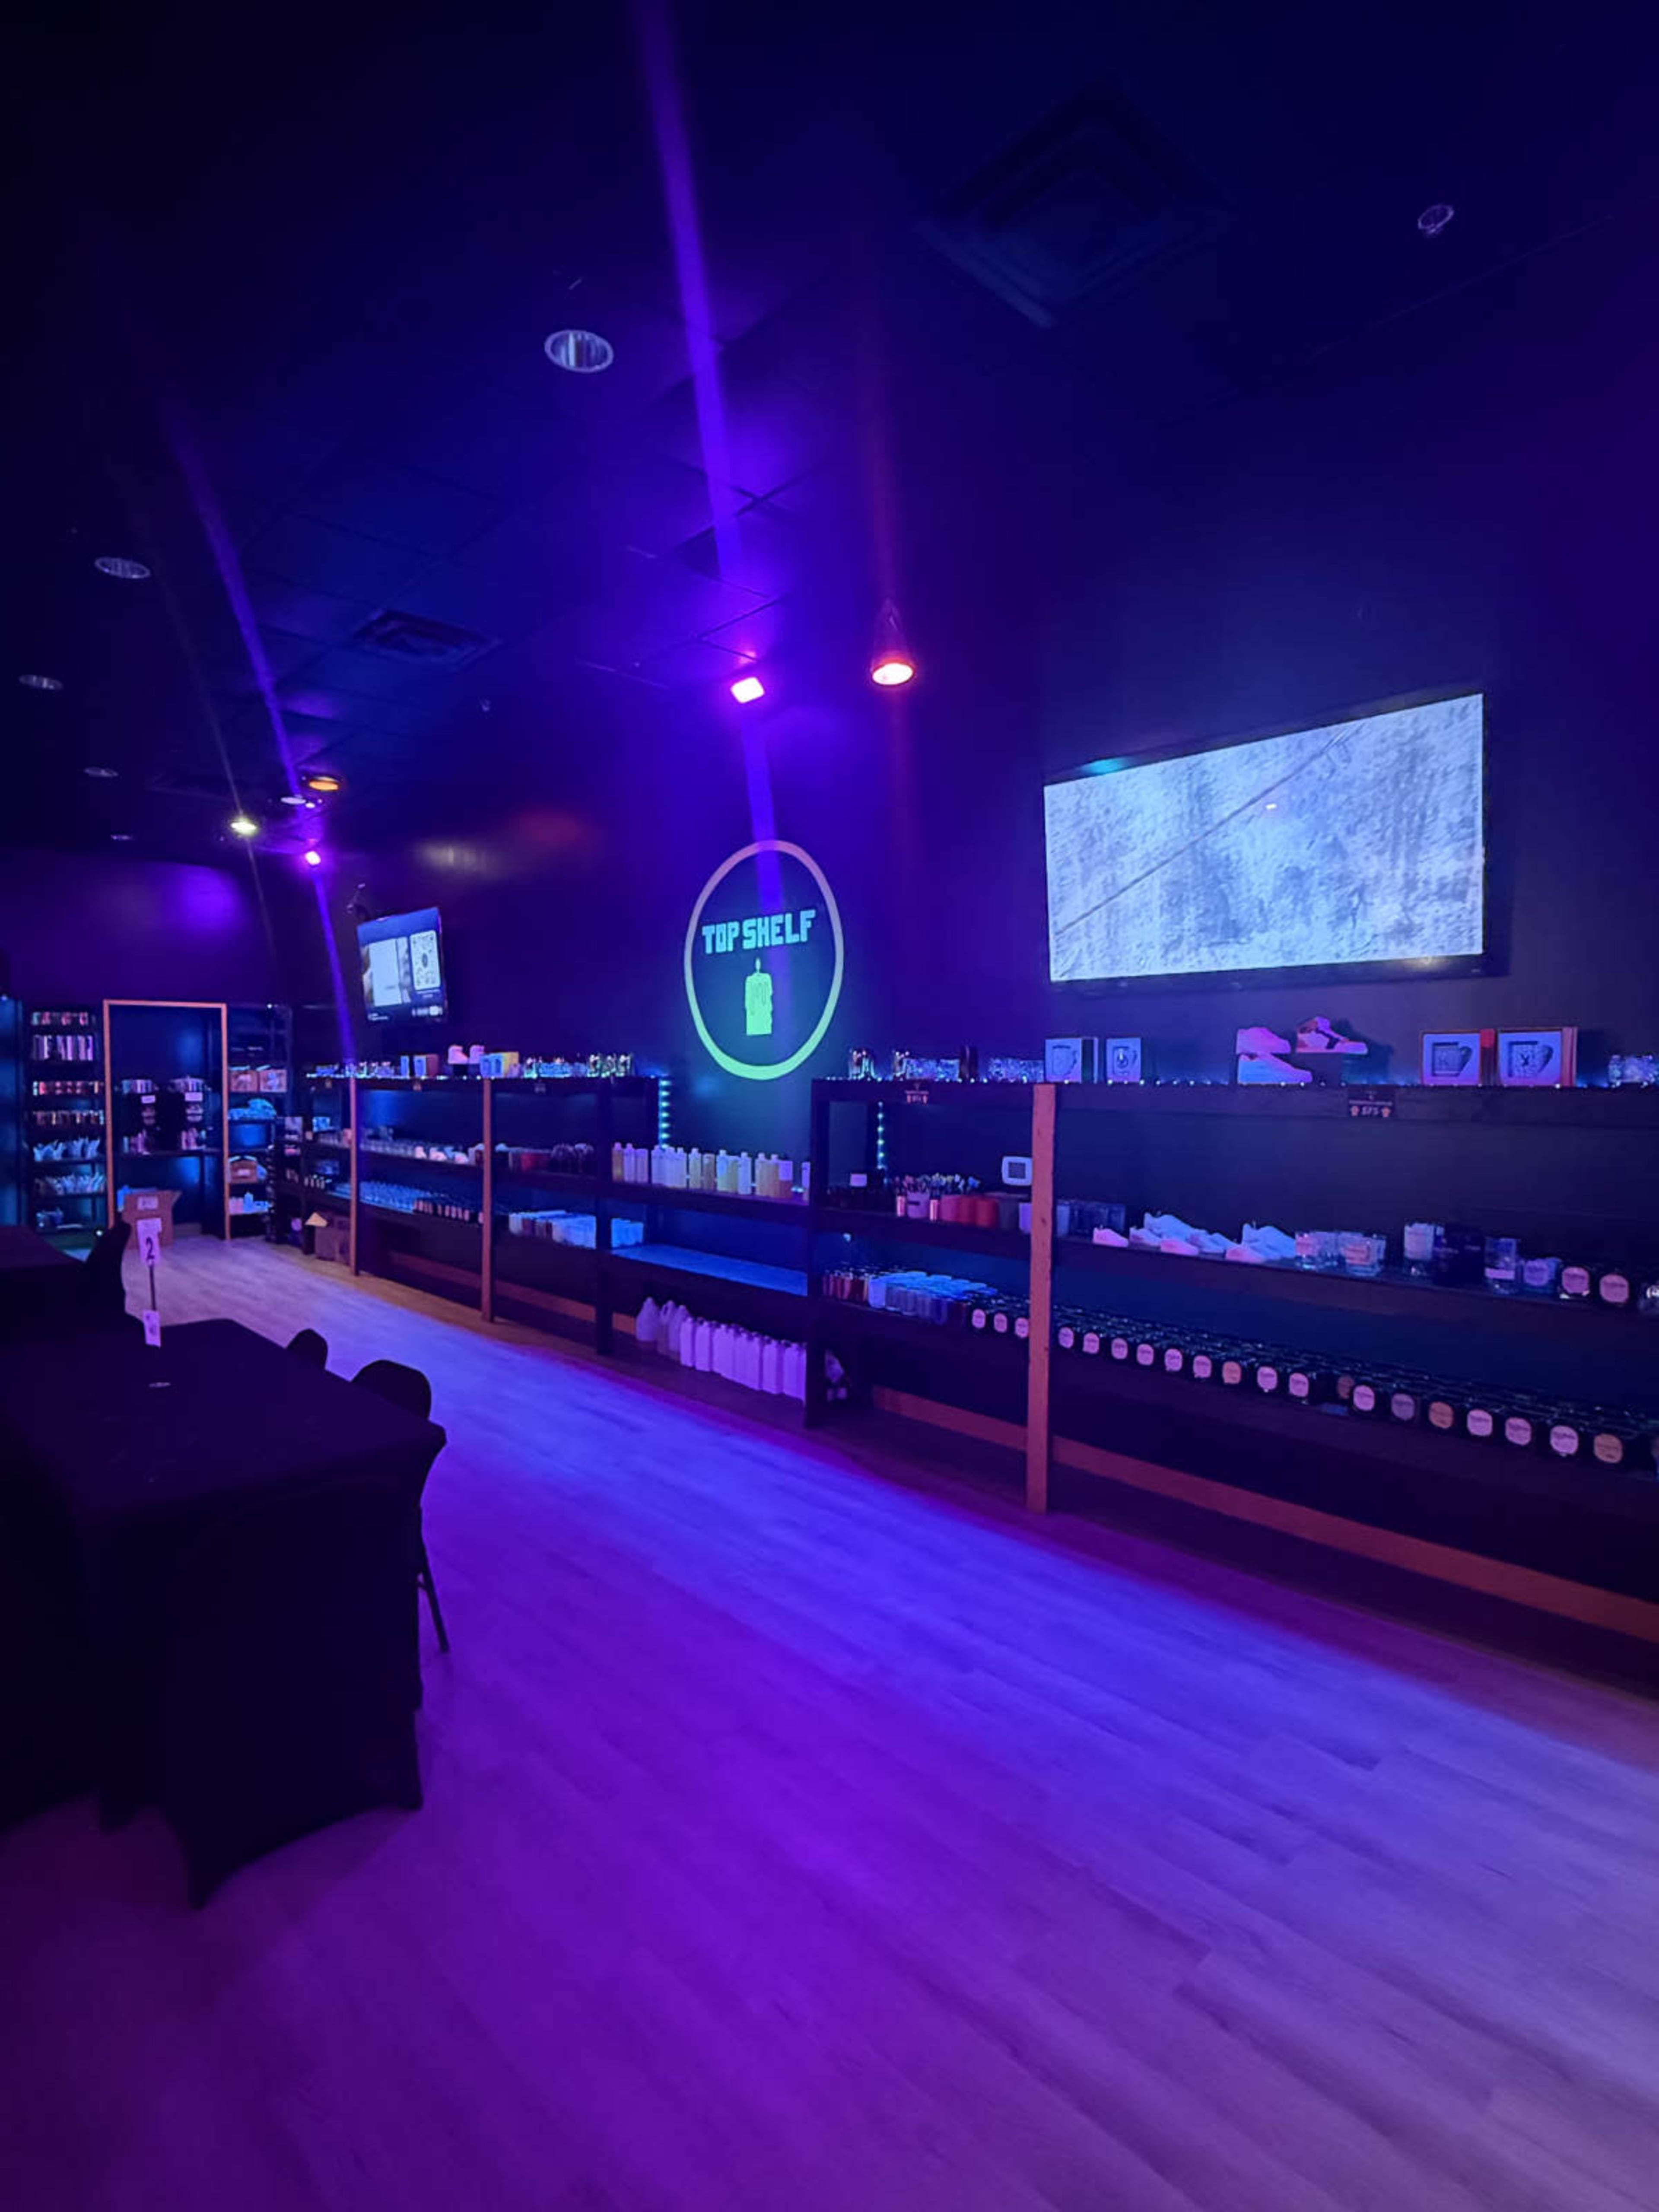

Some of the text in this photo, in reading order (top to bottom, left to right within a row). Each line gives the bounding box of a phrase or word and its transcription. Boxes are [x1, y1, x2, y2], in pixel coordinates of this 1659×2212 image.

[702, 909, 816, 954] TOP SHELF
[146, 1237, 155, 1260] 2
